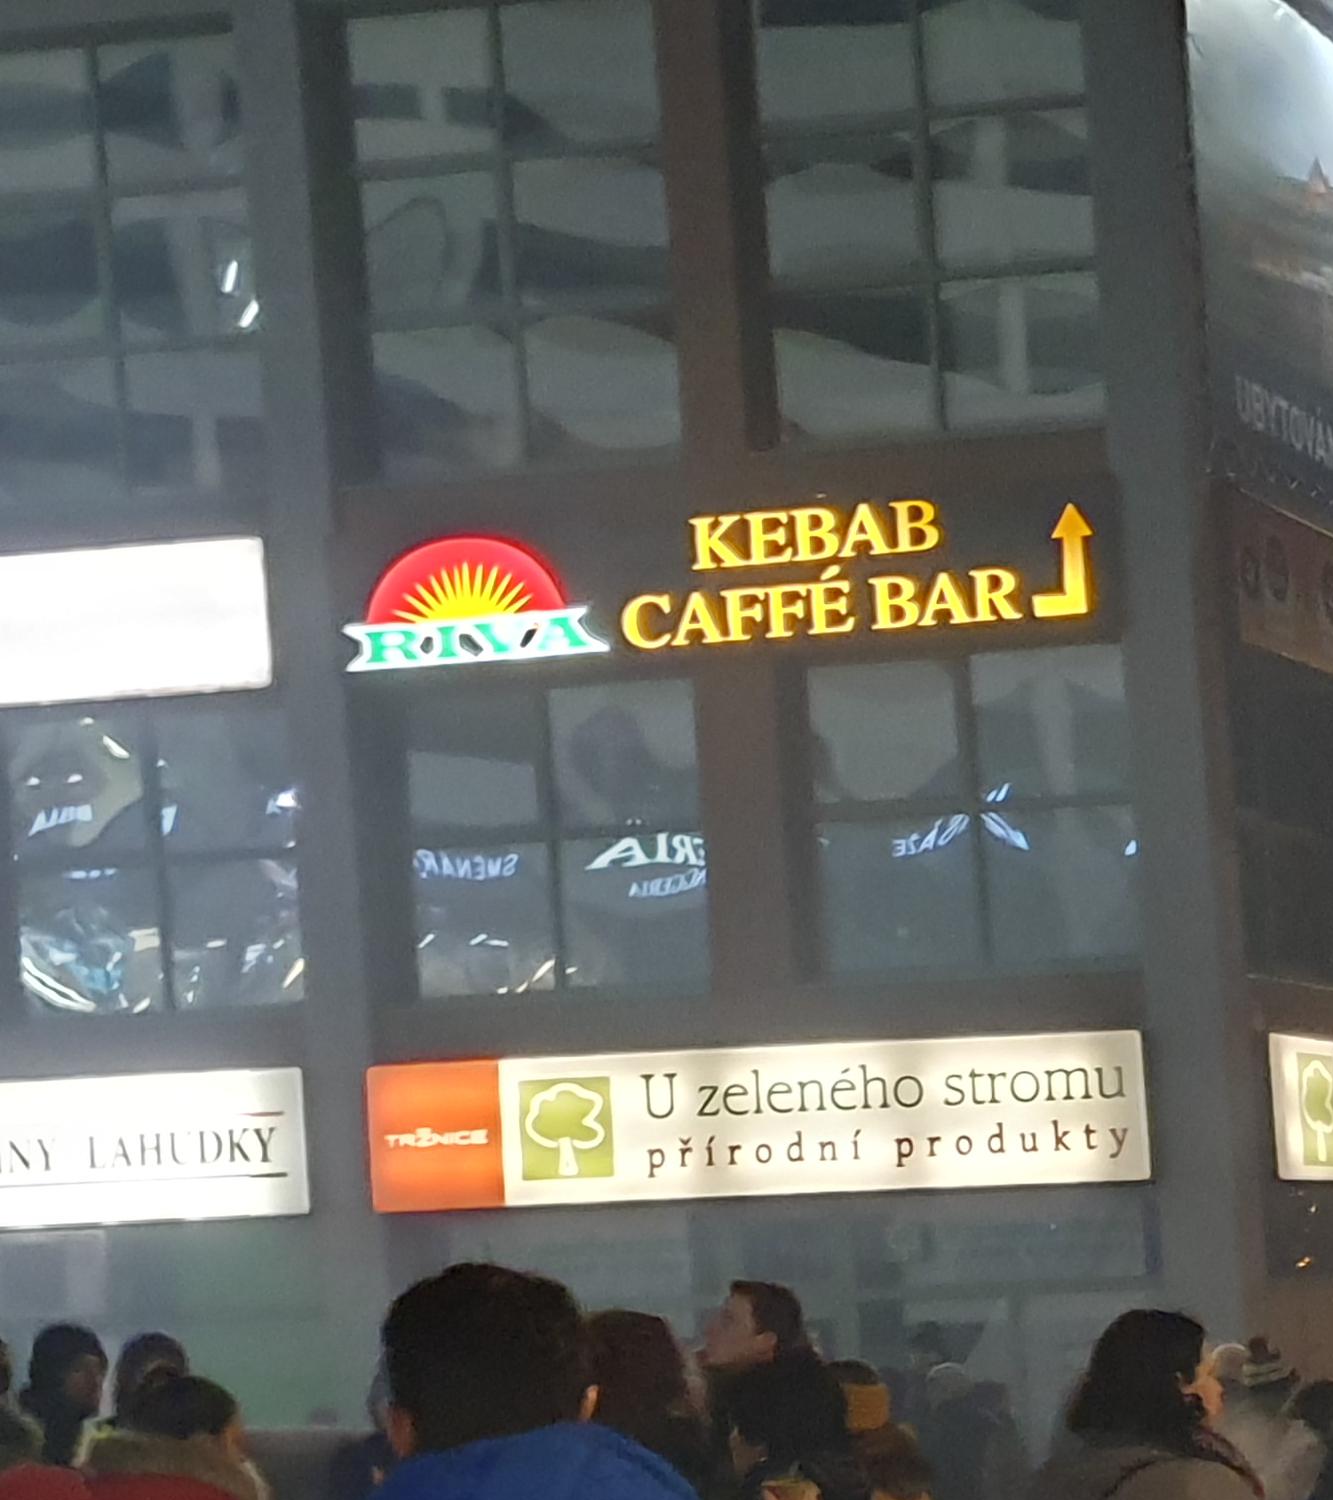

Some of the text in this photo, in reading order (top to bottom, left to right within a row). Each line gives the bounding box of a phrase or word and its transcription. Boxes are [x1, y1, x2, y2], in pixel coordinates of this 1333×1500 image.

[687, 499, 941, 571] KEBAB
[621, 564, 1023, 650] CAFFÉ BAR
[364, 616, 589, 664] RIVA
[640, 1064, 1126, 1119] U zeleného stromu
[647, 1119, 1129, 1178] přírodní produkty
